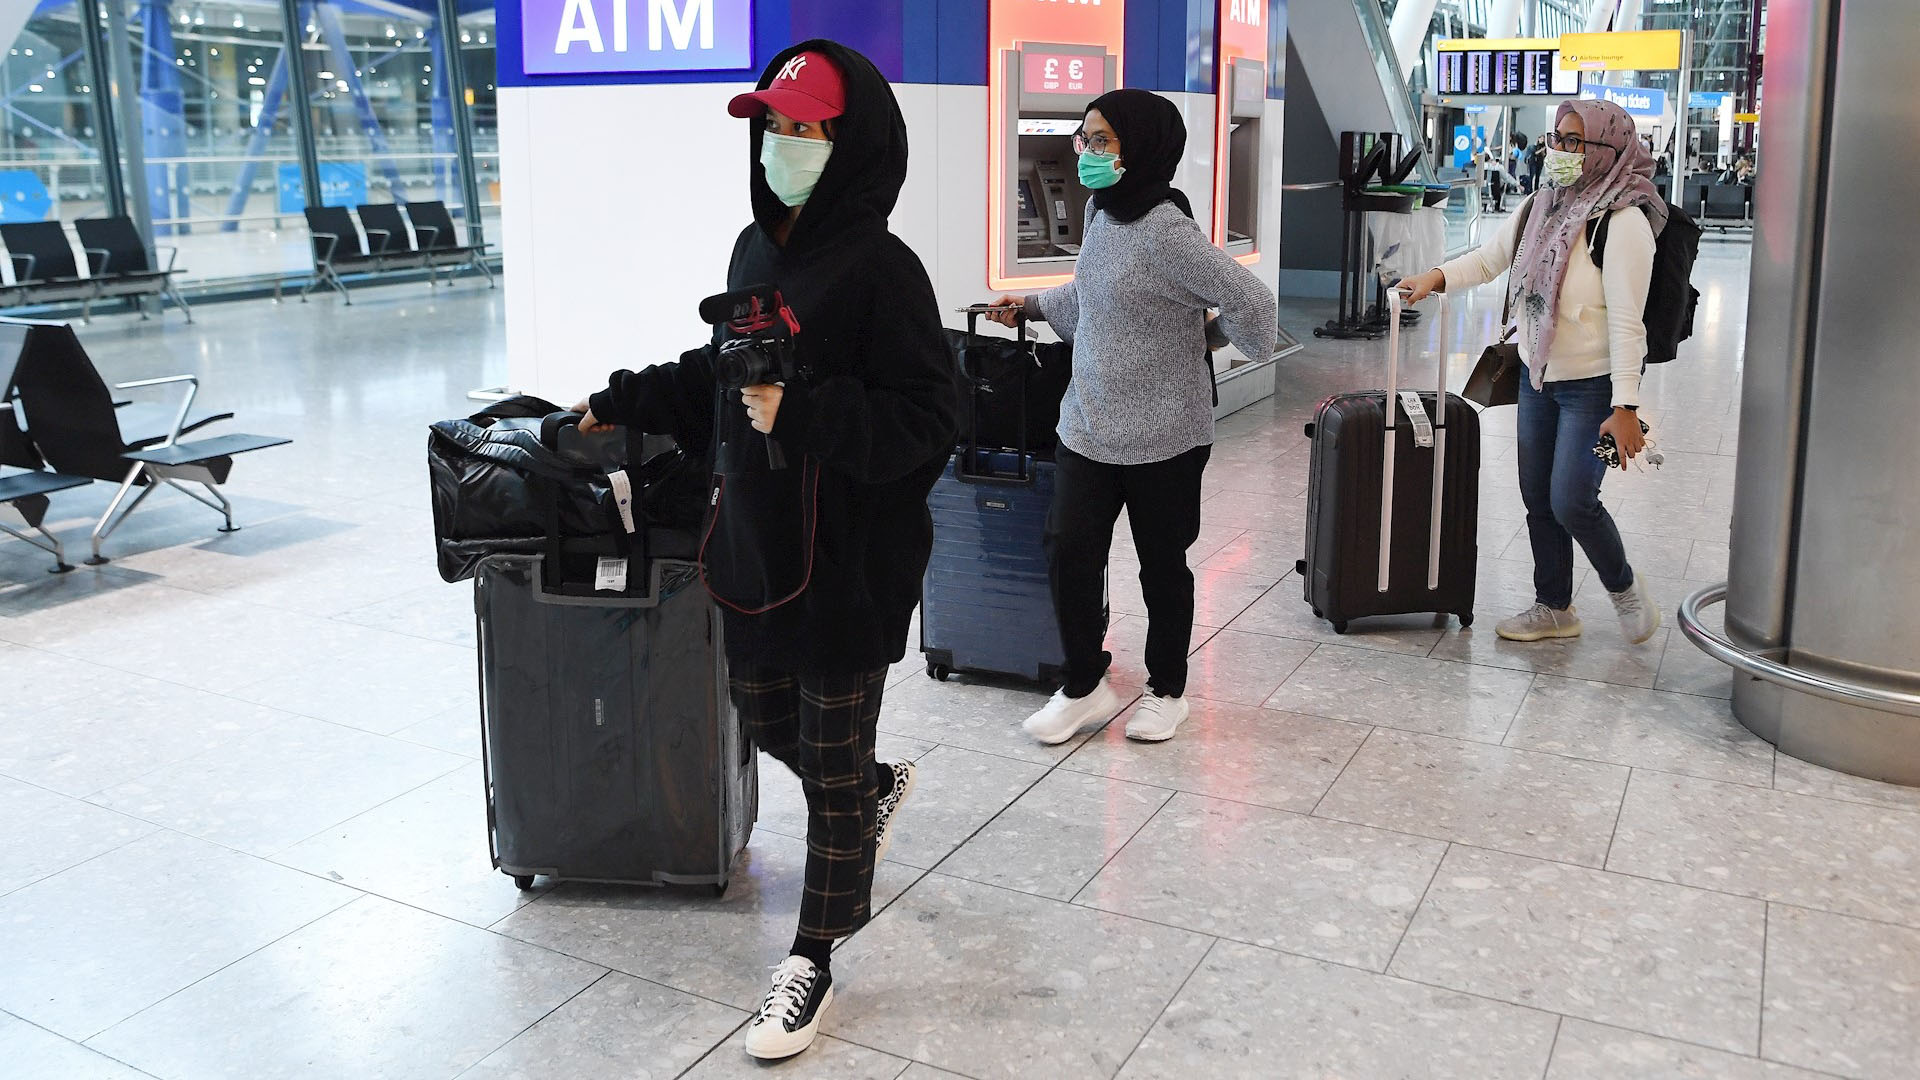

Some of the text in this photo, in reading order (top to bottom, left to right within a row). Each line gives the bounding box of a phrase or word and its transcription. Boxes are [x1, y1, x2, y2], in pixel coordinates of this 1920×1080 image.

[1229, 0, 1261, 27] ATM
[554, 0, 714, 54] ATM
[775, 55, 807, 80] NY
[1044, 58, 1084, 80] £ €
[1043, 81, 1084, 90] GBP EUR
[1627, 93, 1651, 110] tickets
